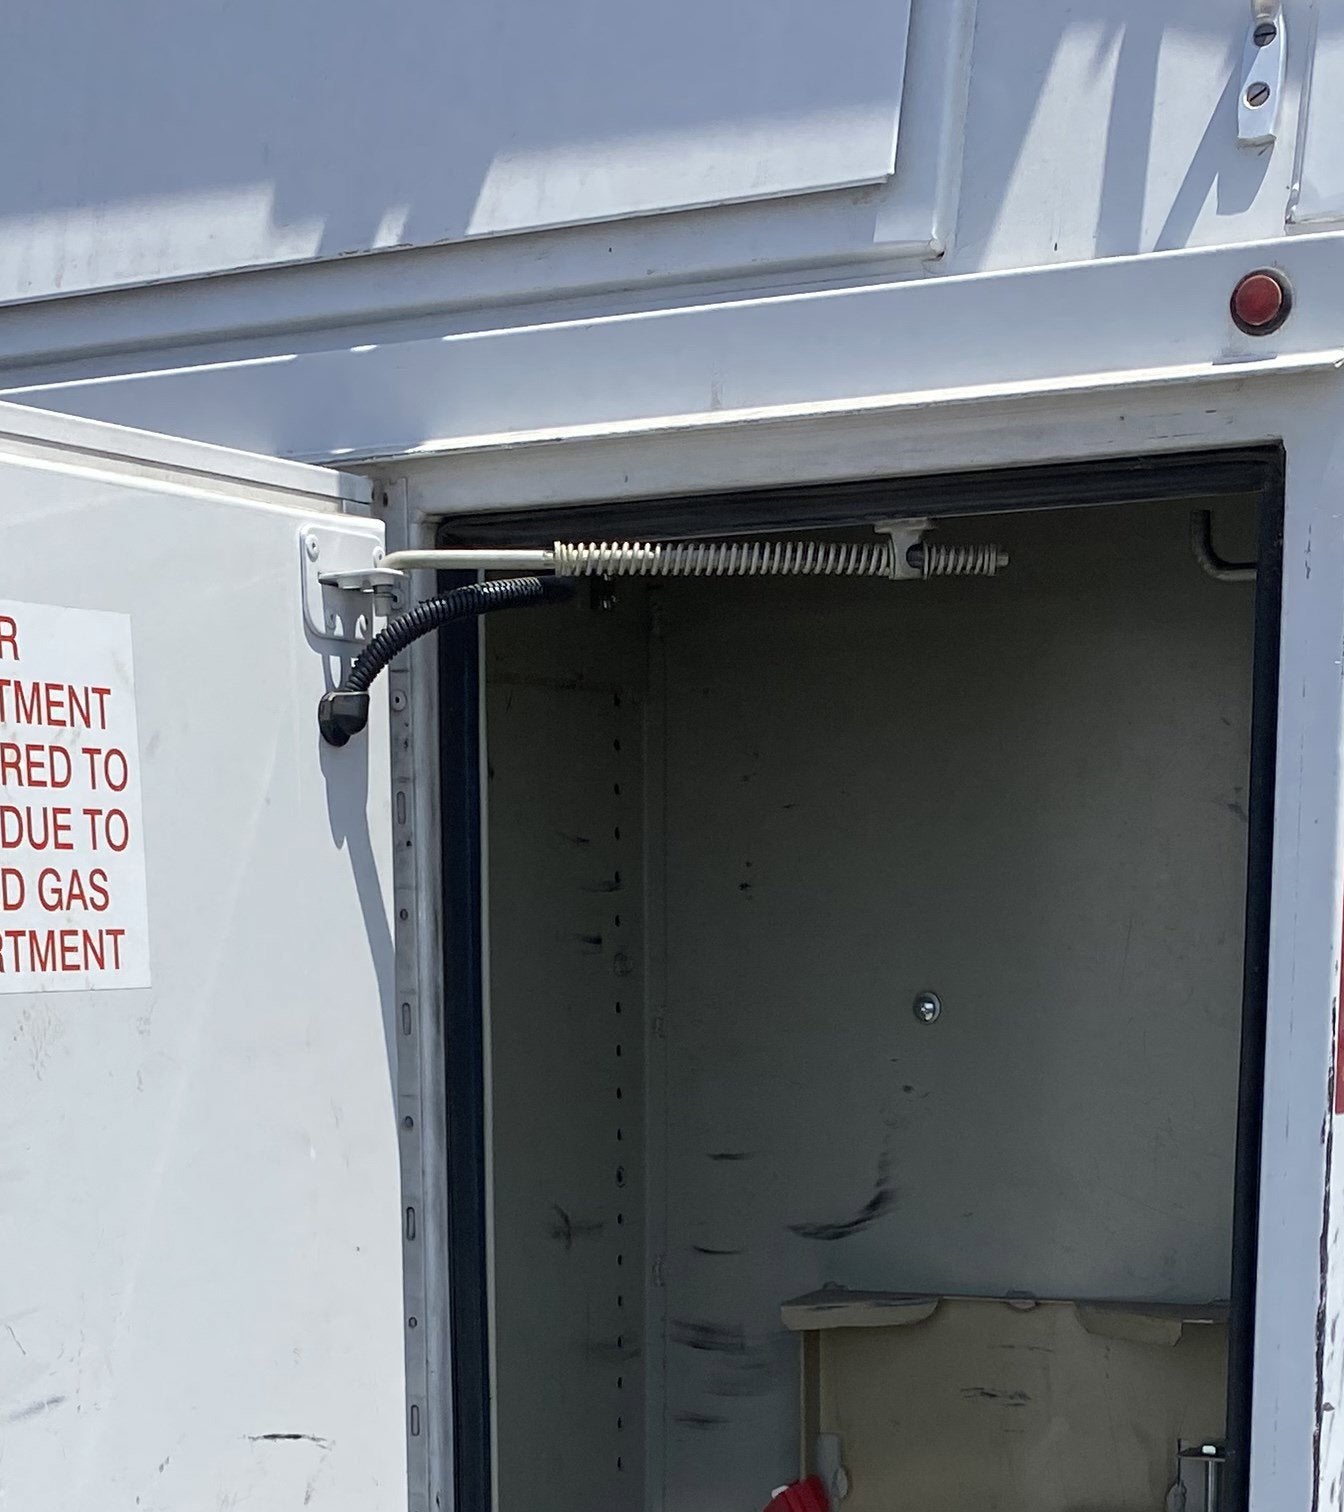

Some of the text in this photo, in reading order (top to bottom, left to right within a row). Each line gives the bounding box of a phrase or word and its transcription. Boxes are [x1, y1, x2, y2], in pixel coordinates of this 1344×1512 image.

[83, 747, 127, 791] TO
[0, 806, 73, 850] DUE
[84, 808, 128, 851] TO
[39, 868, 108, 911] GAS
